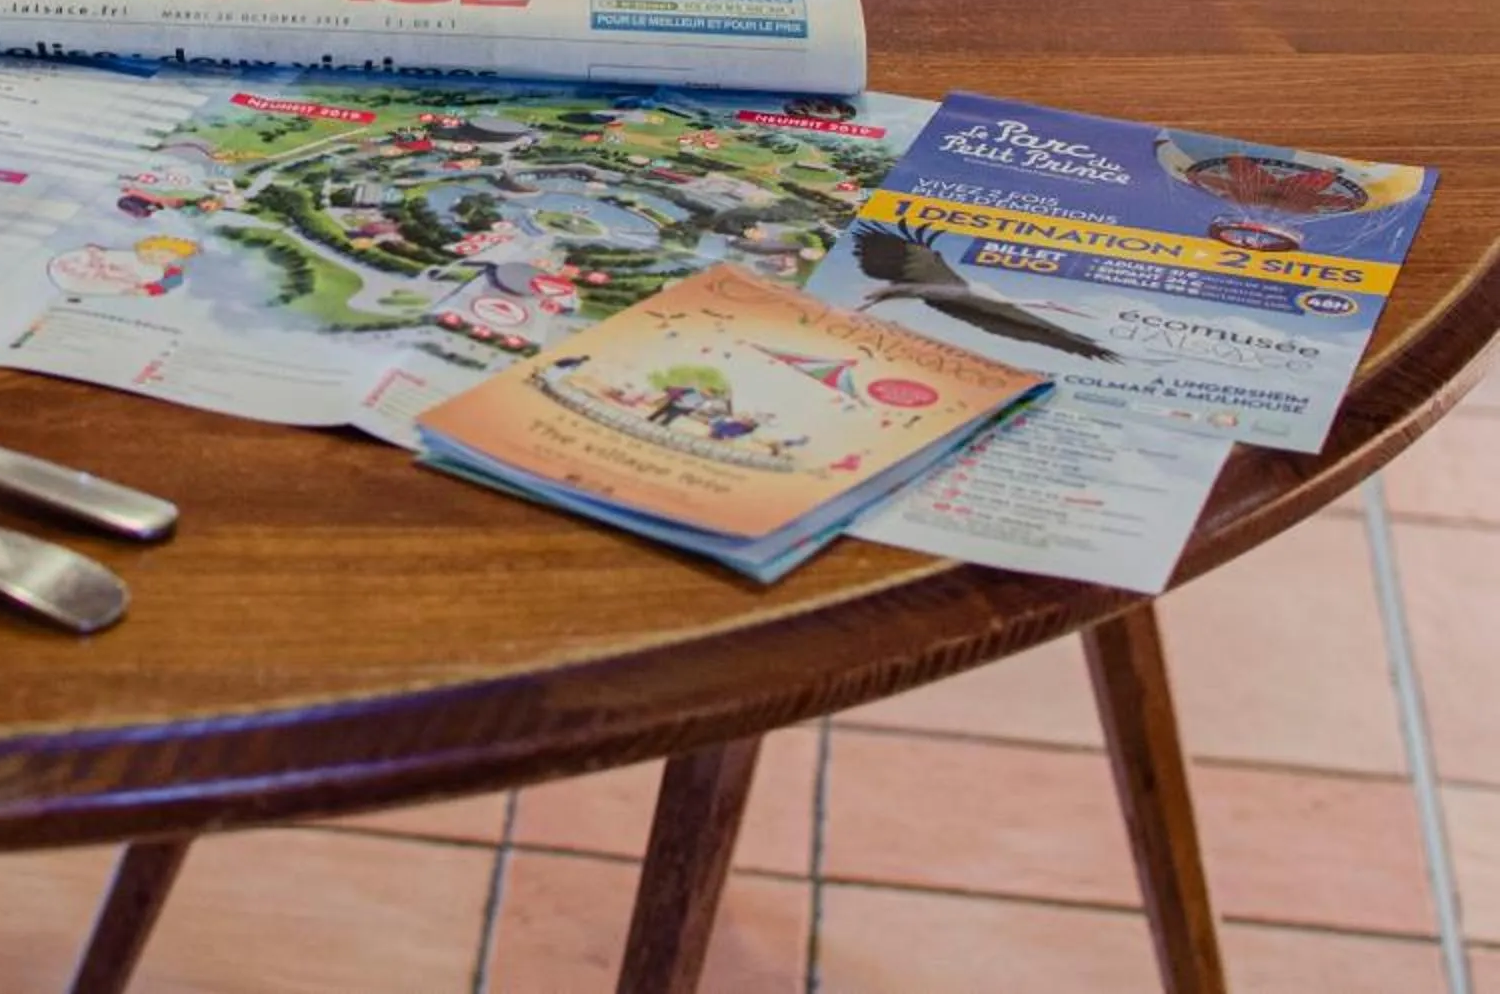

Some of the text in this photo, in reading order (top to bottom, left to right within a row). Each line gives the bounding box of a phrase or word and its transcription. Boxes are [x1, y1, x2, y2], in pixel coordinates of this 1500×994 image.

[596, 14, 630, 27] POUR
[649, 16, 706, 29] MEILLEUR
[707, 18, 723, 29] ET
[724, 18, 757, 31] POUR
[758, 20, 774, 31] LE
[246, 96, 316, 114] NEUHEIT
[754, 113, 825, 129] NEUHEIT
[959, 125, 990, 139] Le
[994, 119, 1098, 159] Parc
[1087, 156, 1125, 172] du
[938, 134, 1016, 164] Petit
[1019, 148, 1132, 186] Prince
[911, 185, 973, 203] PLUS
[917, 177, 985, 194] VIVEZ
[1008, 190, 1060, 206] FOIS
[893, 199, 912, 216] 1
[918, 205, 1185, 257] DESTINATION
[1214, 250, 1252, 270] 2
[1260, 258, 1366, 284] SITES
[983, 241, 1068, 262] BILLET
[975, 251, 1060, 273] DUO
[1118, 310, 1321, 357] écomusée
[1063, 374, 1159, 397] COLMAR
[1184, 391, 1306, 415] MULHOUSE
[1172, 379, 1311, 405] UNGERSHEIM
